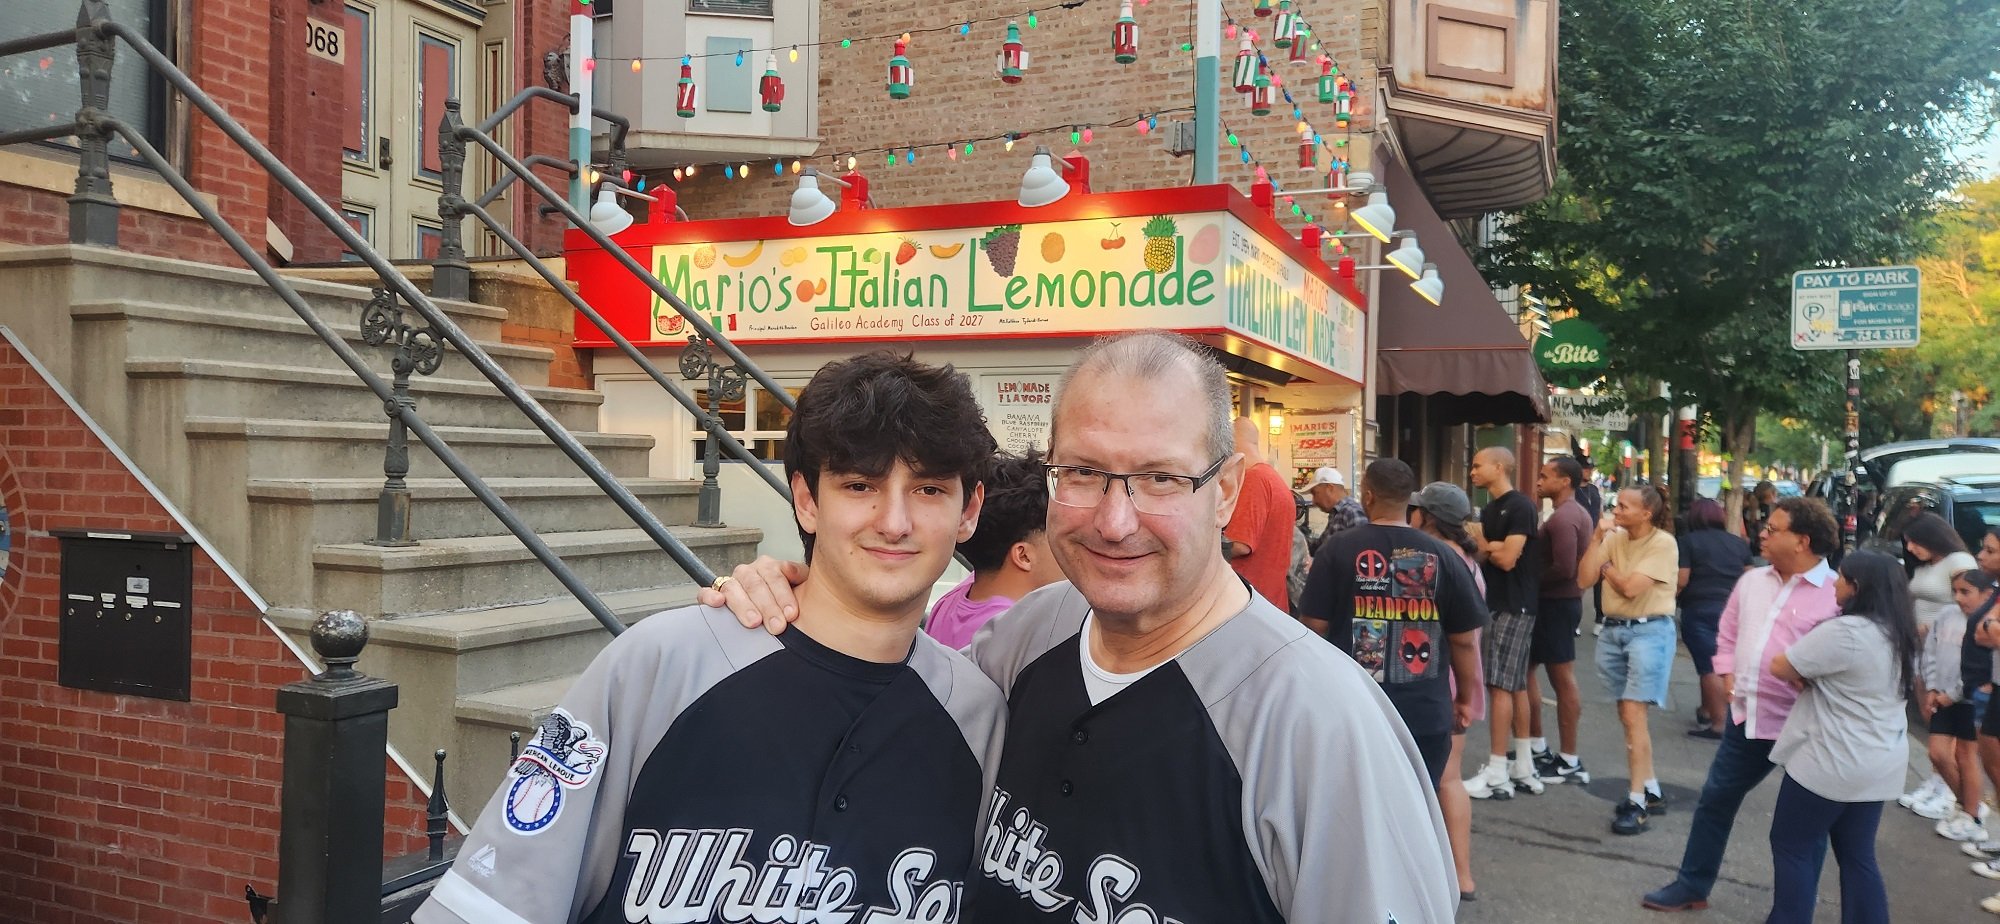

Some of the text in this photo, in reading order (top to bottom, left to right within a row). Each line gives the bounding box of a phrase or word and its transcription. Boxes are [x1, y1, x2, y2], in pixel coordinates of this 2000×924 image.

[652, 253, 792, 318] Mario's
[815, 244, 948, 313] Italian
[968, 234, 1216, 314] Lemonade
[1802, 271, 1910, 288] PAY TO PARK
[1225, 254, 1281, 345] ITALIAN
[810, 313, 984, 332] Galileo Academy Class of 2027
[1544, 342, 1600, 364] the Bite
[997, 381, 1051, 394] LEMONADE
[998, 394, 1052, 404] FLAVORS
[1007, 413, 1041, 422] BANANA
[1019, 420, 1049, 429] RASPBERRY
[1298, 437, 1335, 449] 1954
[549, 761, 575, 781] LEAGUE
[980, 786, 1075, 913] hite
[622, 828, 965, 924] White So
